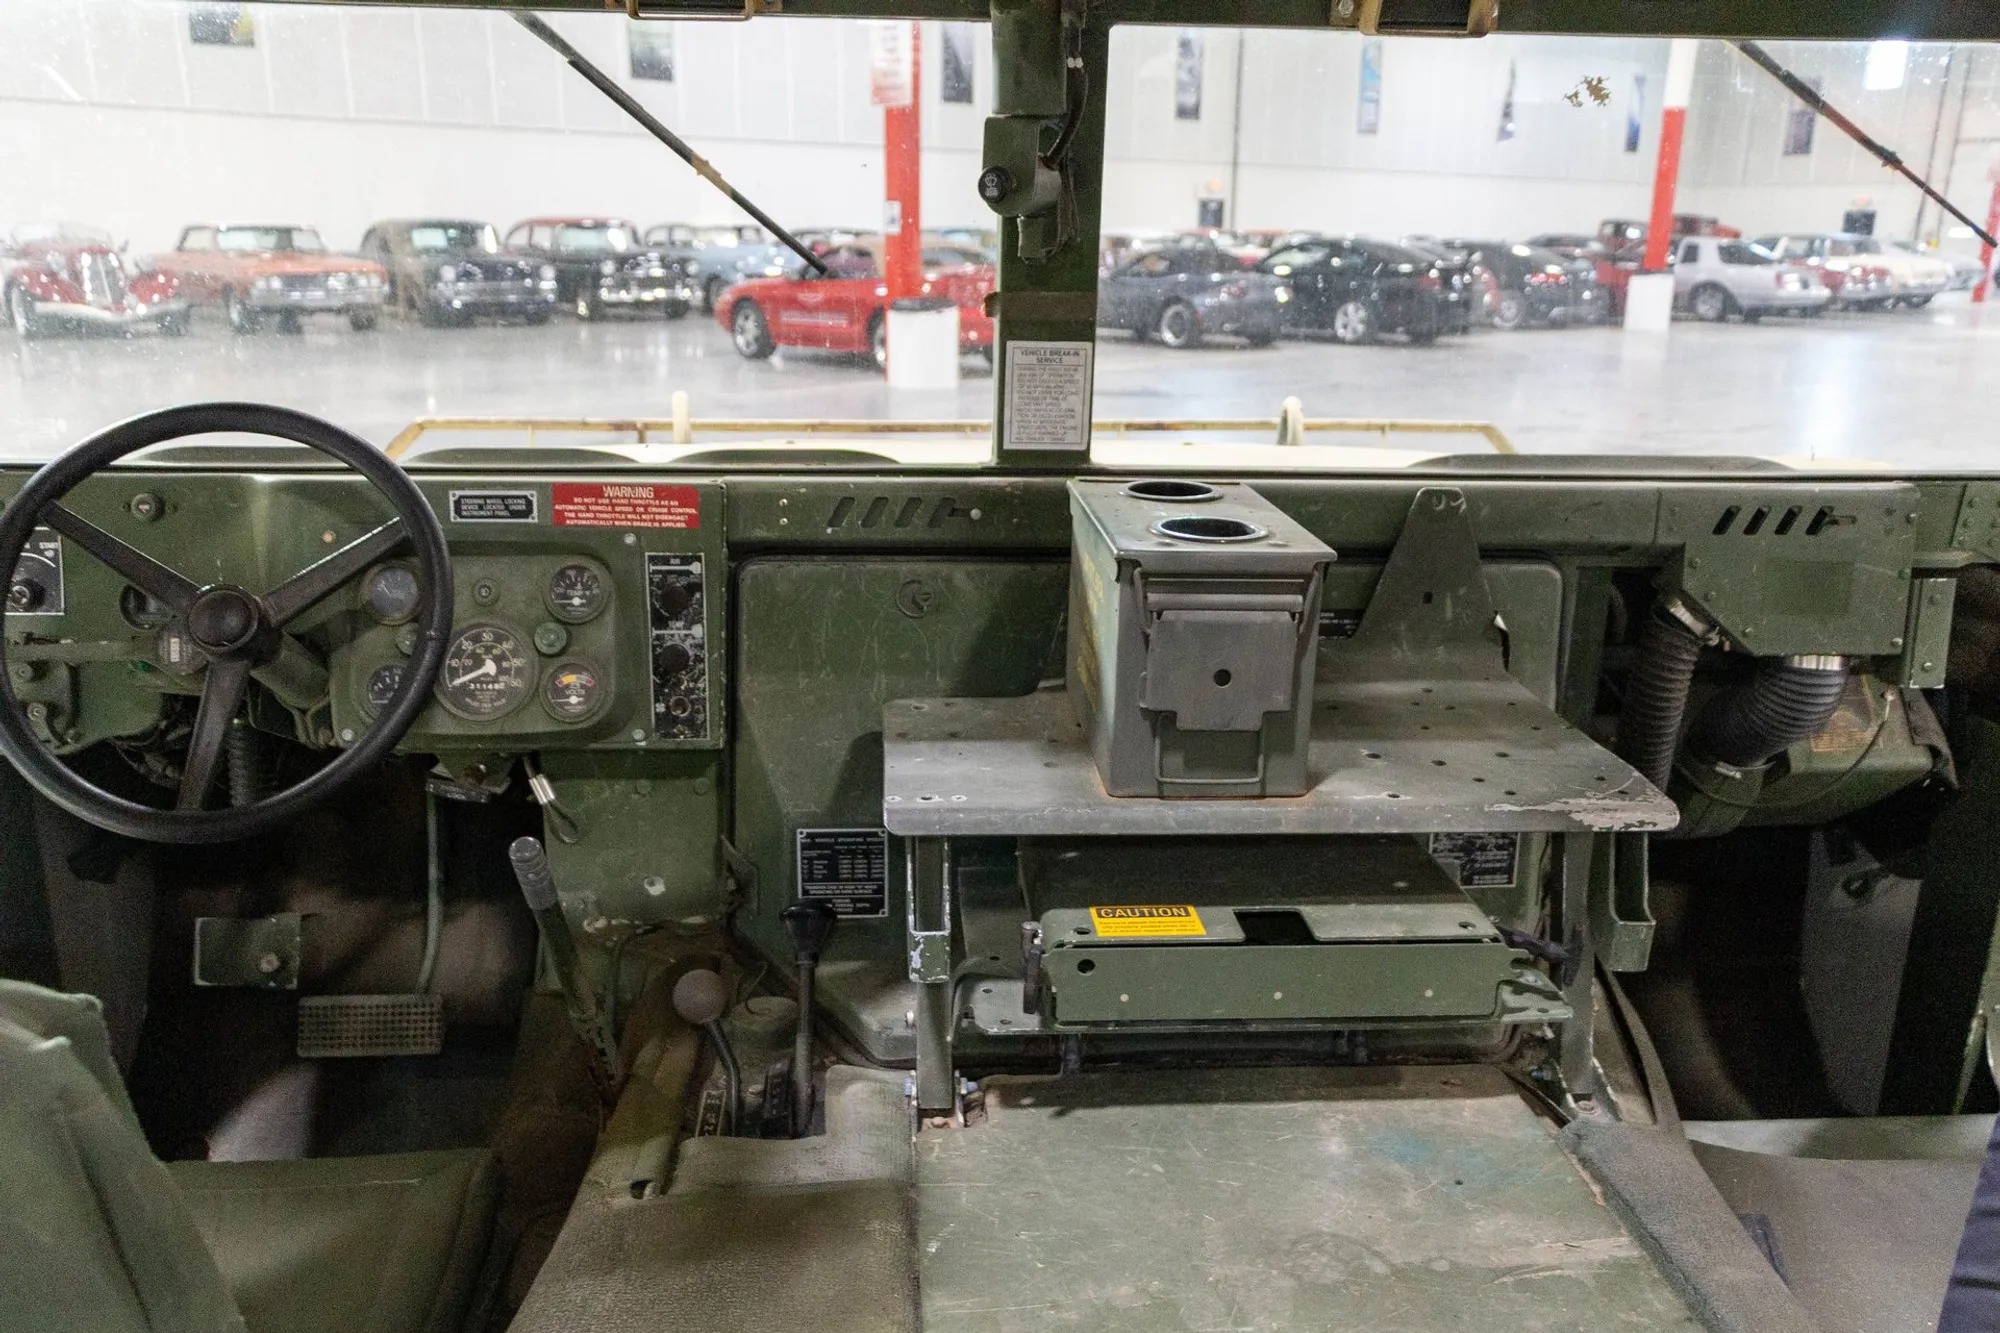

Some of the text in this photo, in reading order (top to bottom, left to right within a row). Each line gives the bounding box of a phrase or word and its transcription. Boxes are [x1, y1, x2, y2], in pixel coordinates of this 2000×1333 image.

[602, 486, 654, 498] WARNING
[482, 632, 494, 641] 30
[1100, 907, 1186, 917] CAUTION
